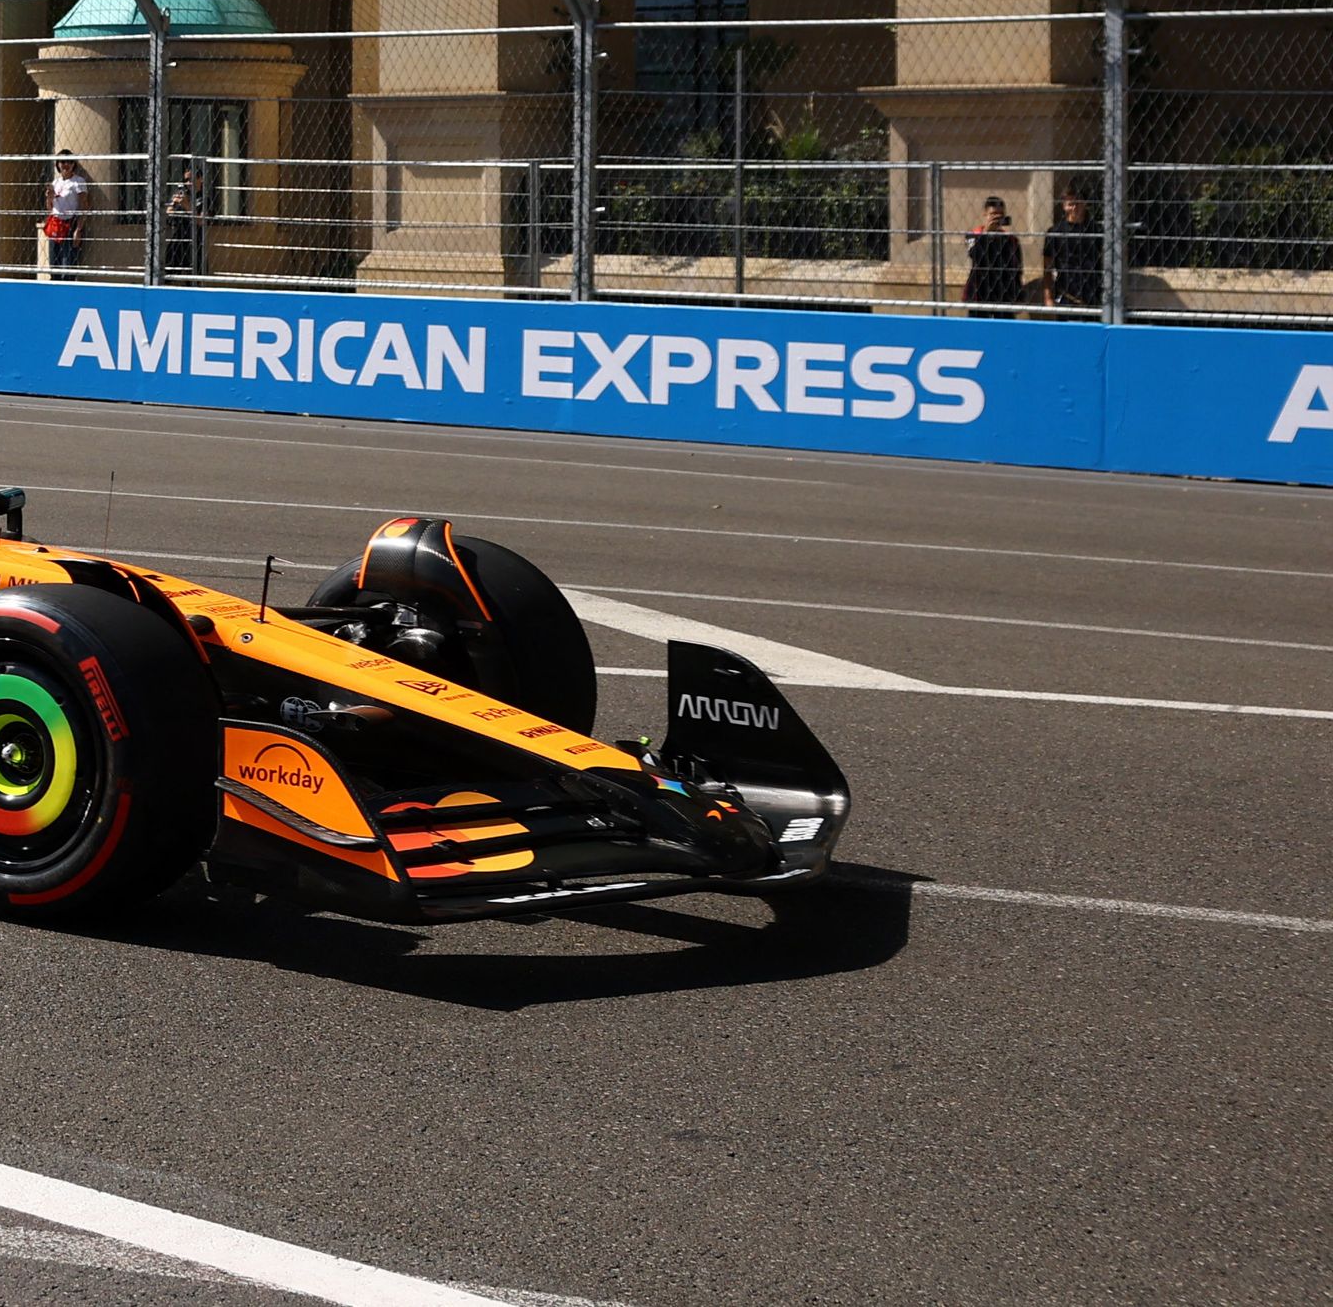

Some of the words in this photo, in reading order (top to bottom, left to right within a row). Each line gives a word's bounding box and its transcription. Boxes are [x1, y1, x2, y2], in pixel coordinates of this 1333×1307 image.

[58, 307, 486, 394] AMERICAN
[520, 329, 986, 426] EXPRESS
[78, 656, 130, 742] PIRELLI
[471, 708, 523, 721] FxPro
[677, 693, 779, 730] ARROW
[238, 765, 324, 794] workday
